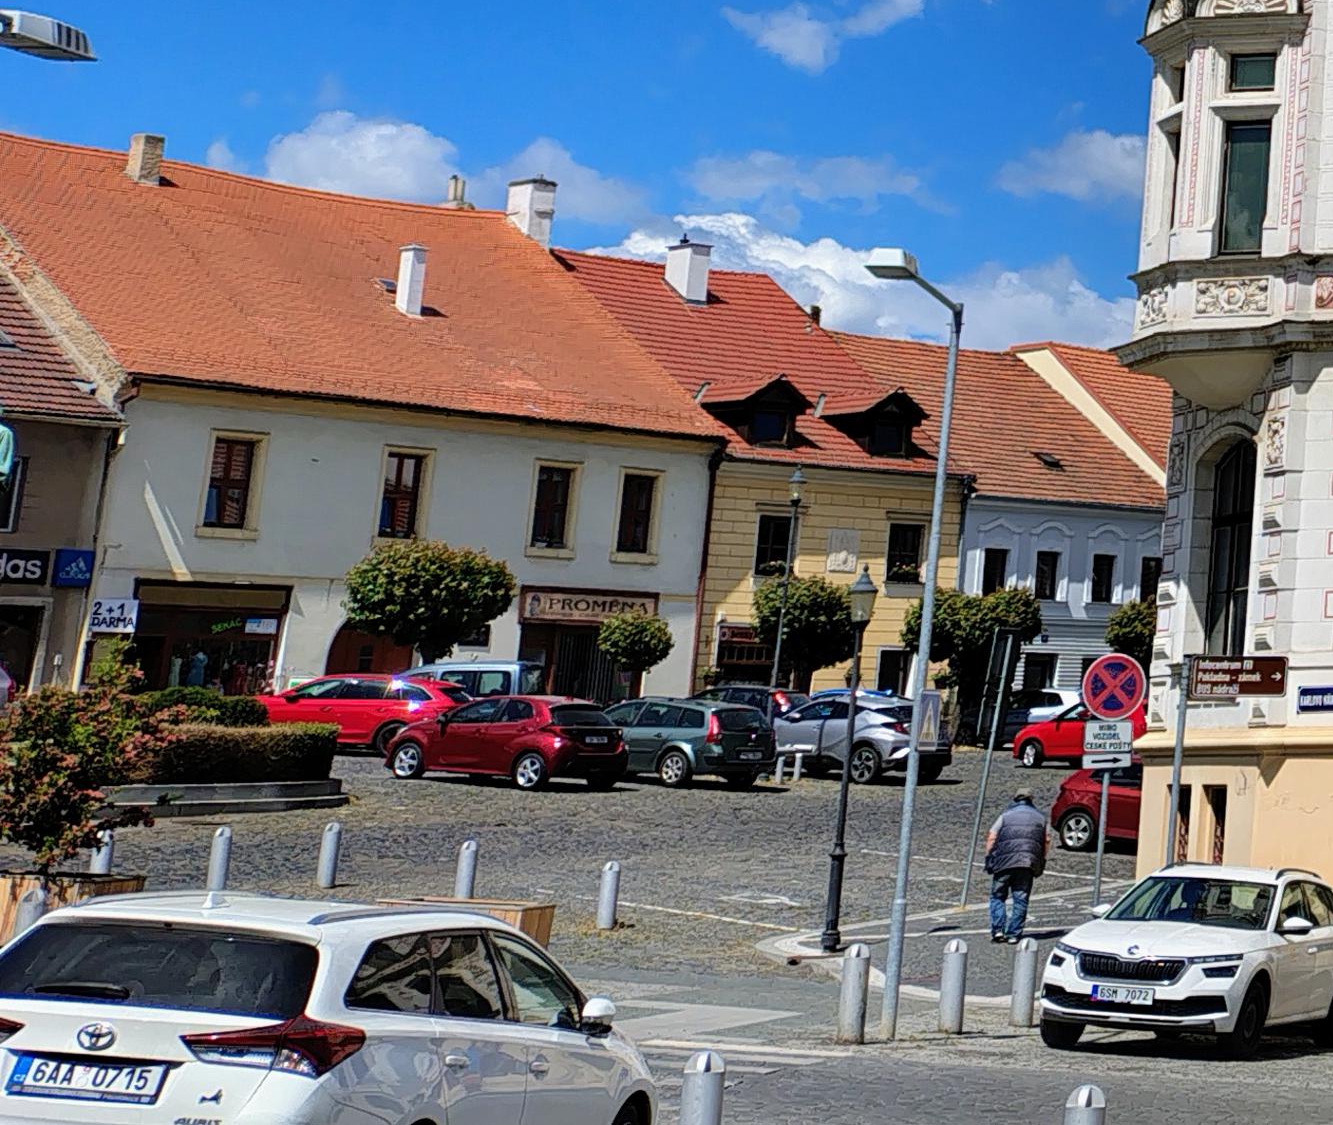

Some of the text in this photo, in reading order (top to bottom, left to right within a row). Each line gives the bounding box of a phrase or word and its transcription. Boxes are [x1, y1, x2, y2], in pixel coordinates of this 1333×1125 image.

[1124, 989, 1150, 1002] 7072
[32, 1061, 151, 1091] 6AA 0715
